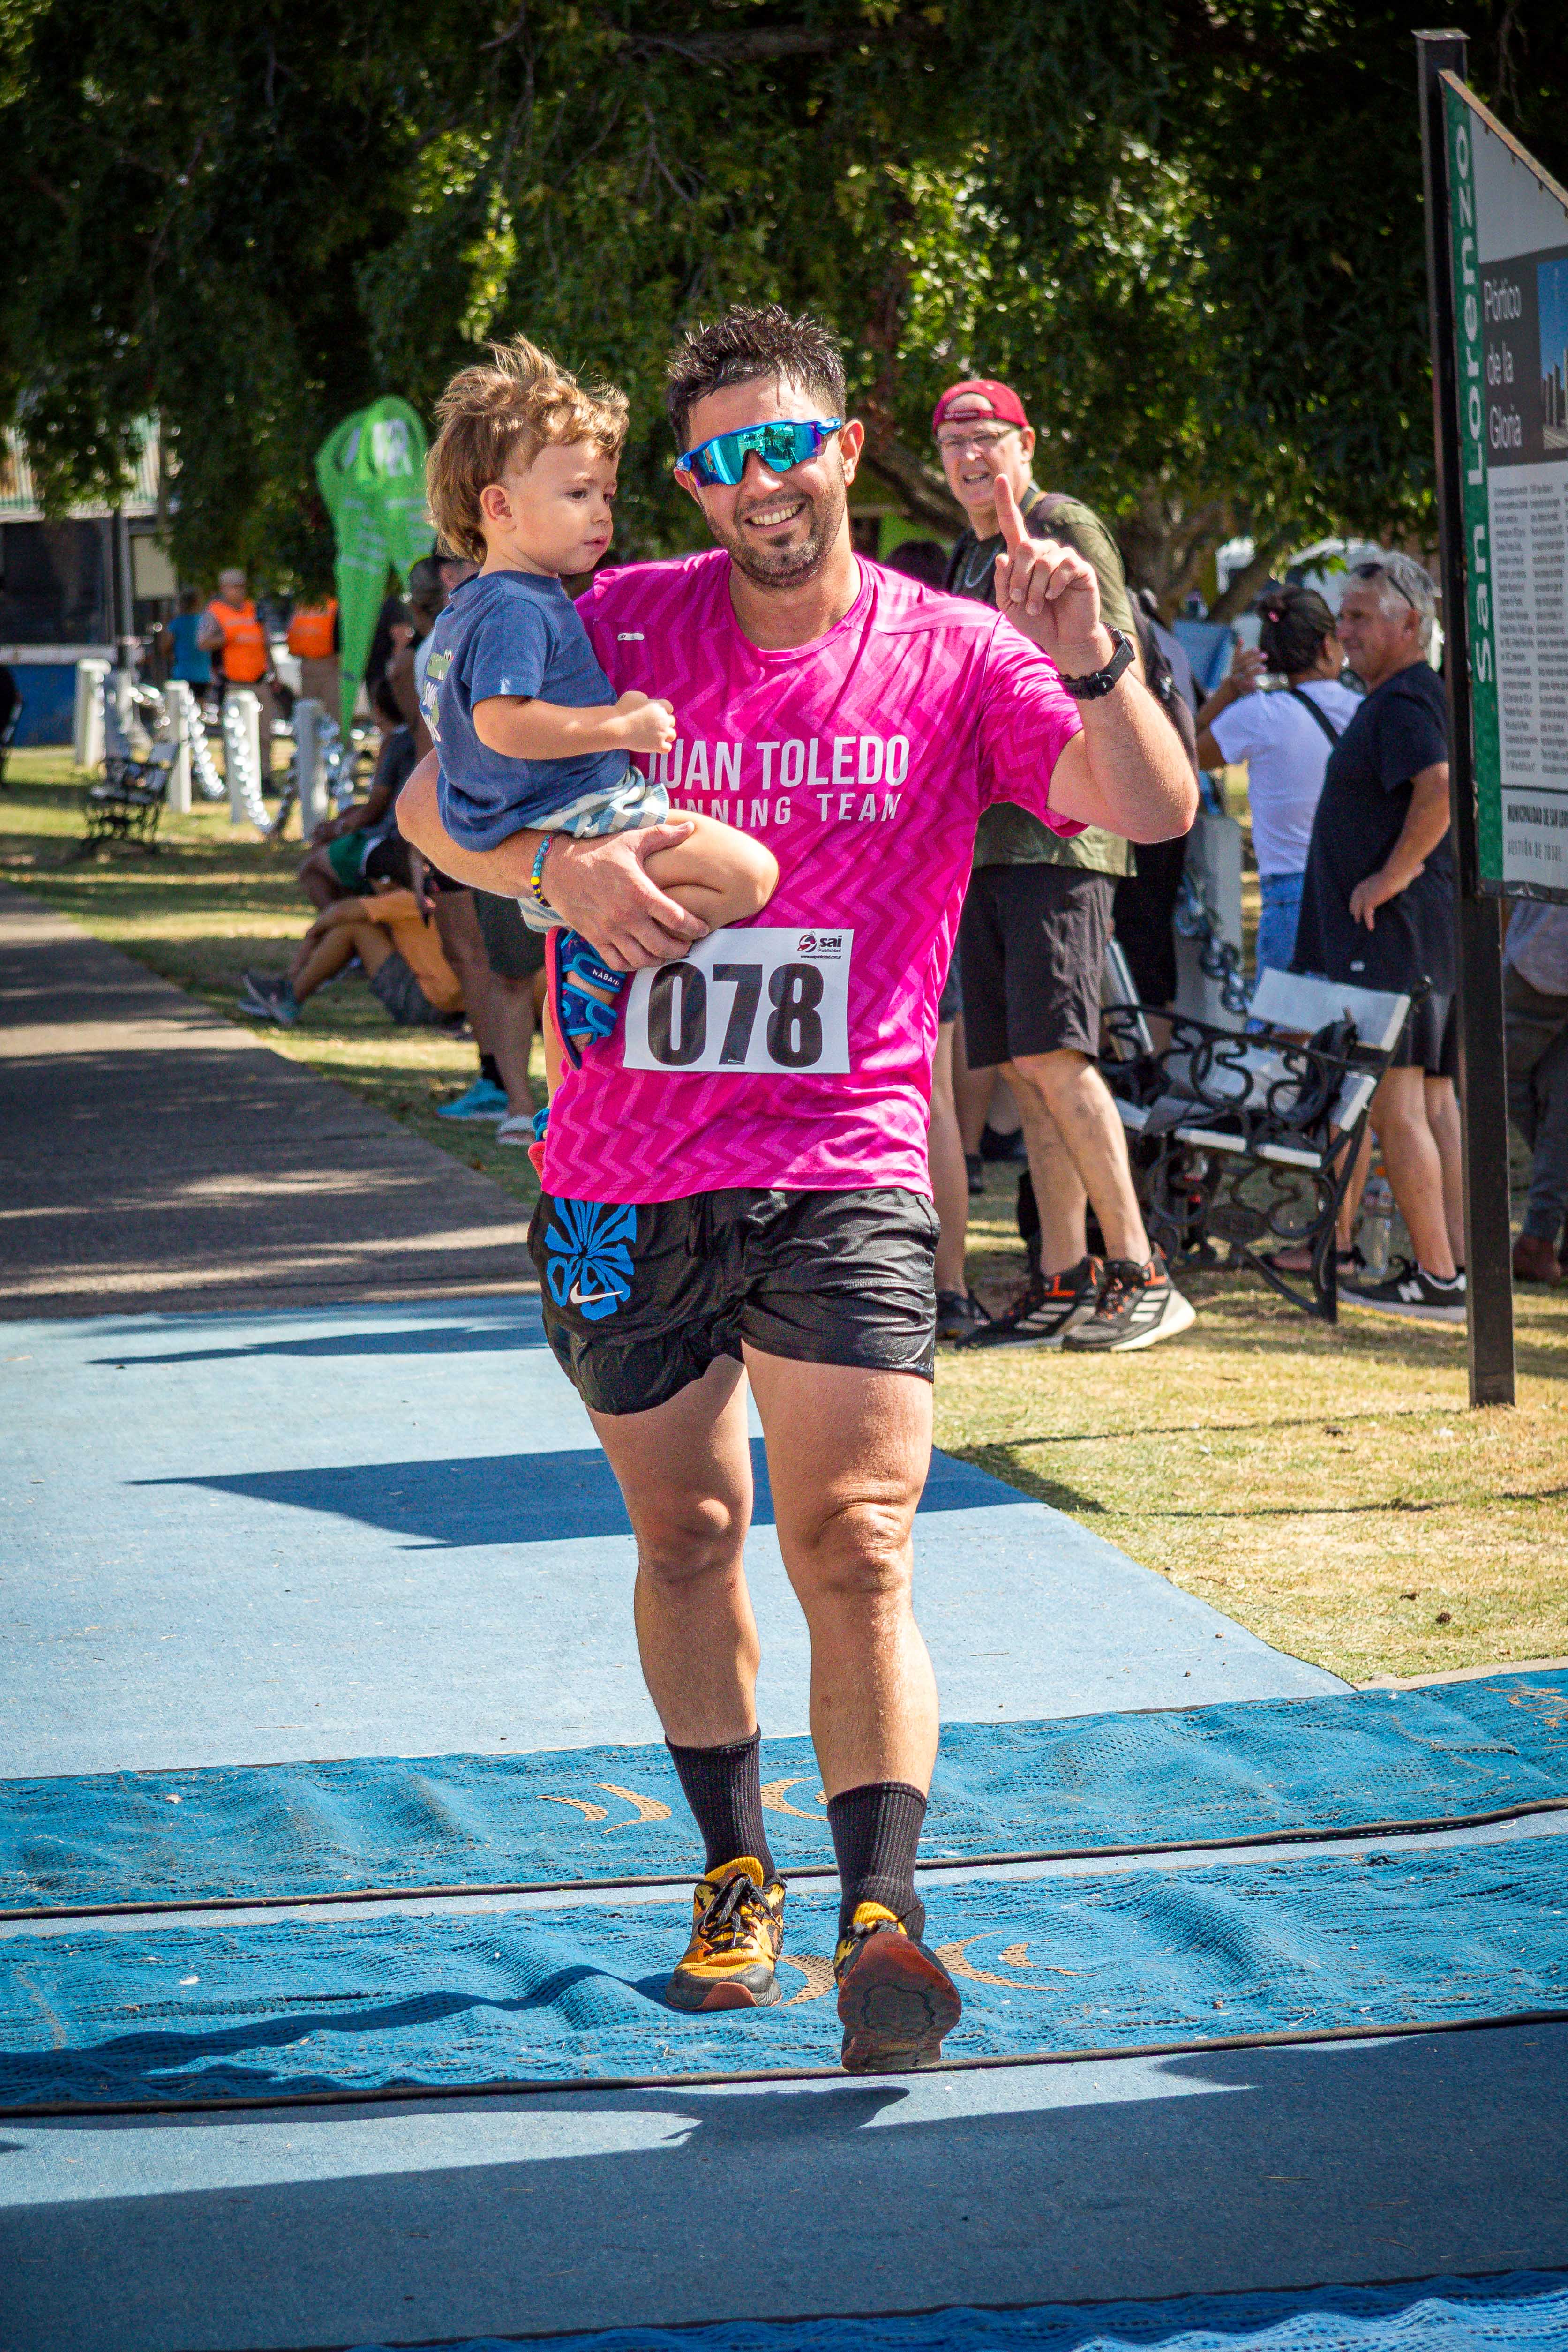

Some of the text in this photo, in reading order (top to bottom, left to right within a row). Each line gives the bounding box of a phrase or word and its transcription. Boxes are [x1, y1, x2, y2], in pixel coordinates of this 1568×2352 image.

[1456, 125, 1483, 485] Lorenzo
[1483, 277, 1522, 322] Pórtico
[1487, 340, 1515, 386] de la
[1489, 404, 1522, 449] Gloria
[756, 734, 910, 790] TOLEDO
[816, 792, 902, 822] TEAM
[819, 935, 842, 948] sai
[647, 961, 825, 1068] 078
